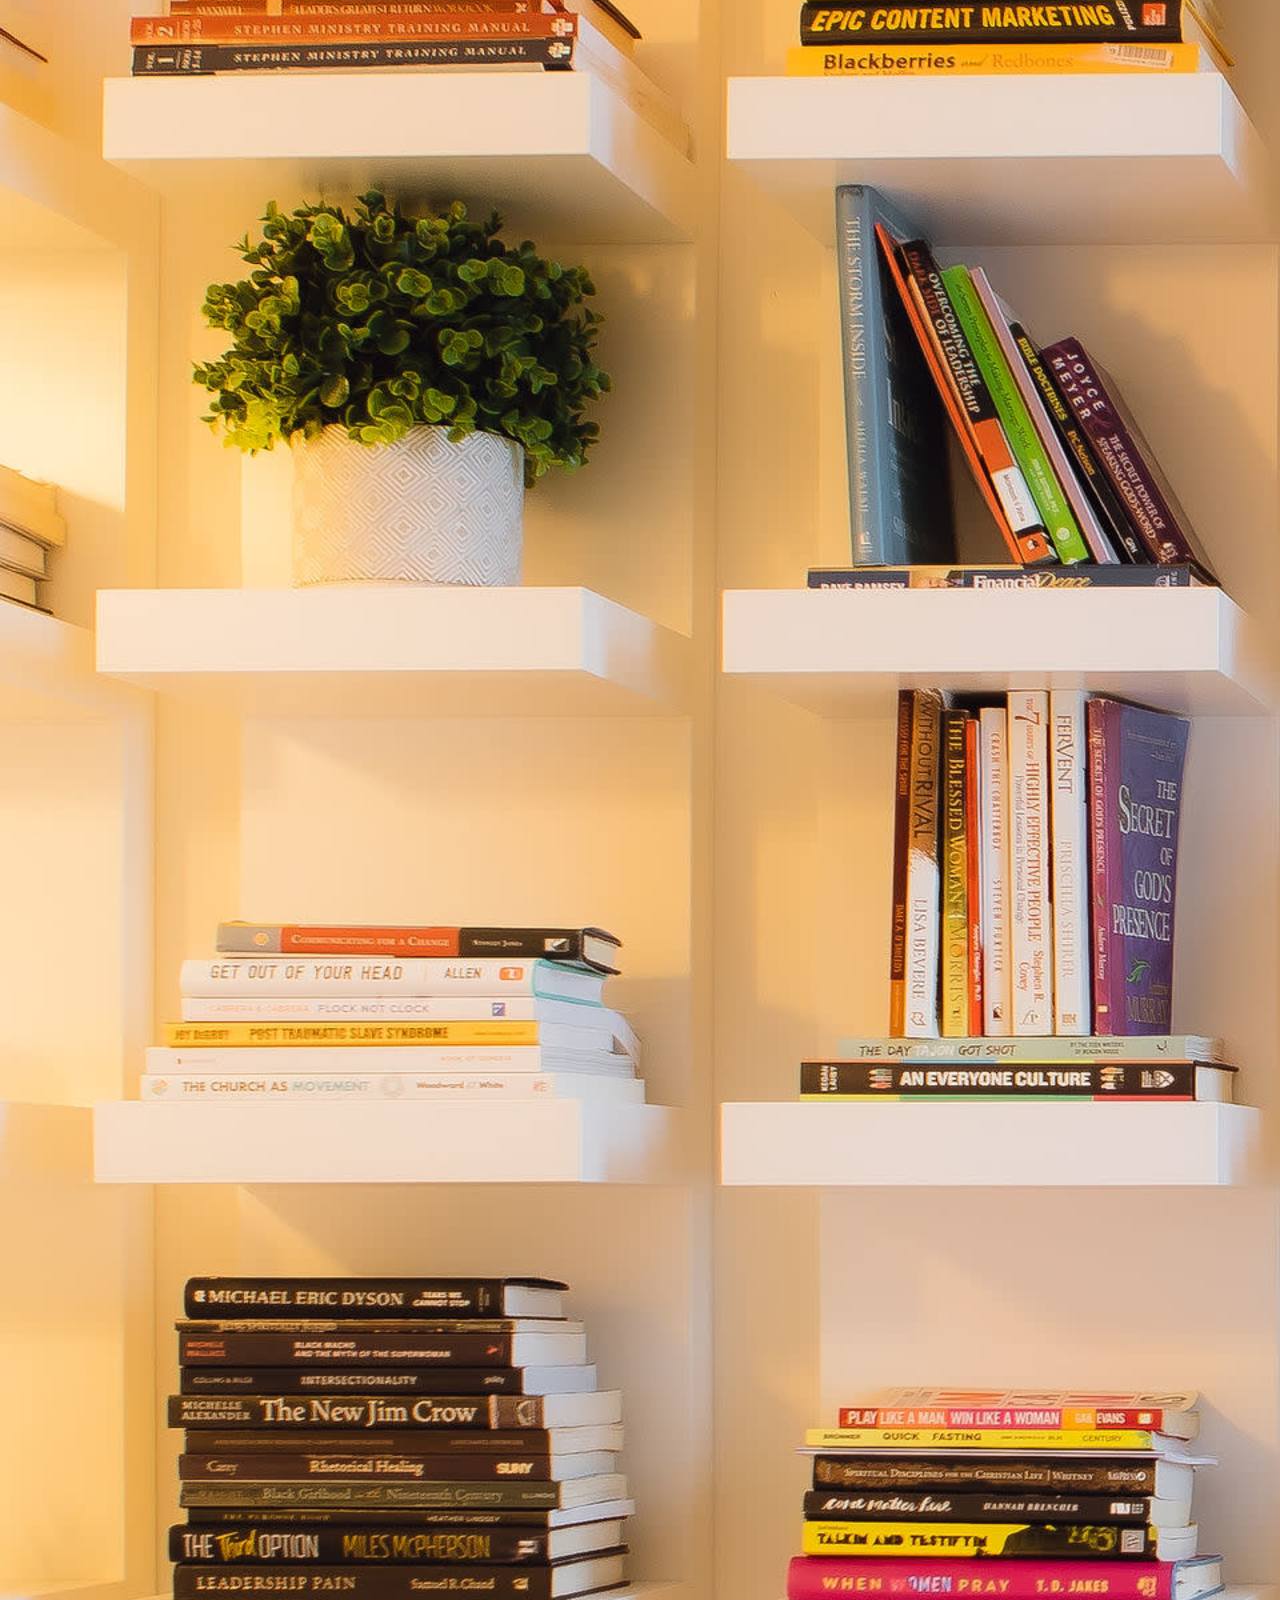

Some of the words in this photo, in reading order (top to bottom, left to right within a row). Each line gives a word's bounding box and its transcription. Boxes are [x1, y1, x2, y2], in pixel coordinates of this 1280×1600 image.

[235, 22, 300, 35] STEPHEN
[308, 22, 381, 34] MINISTRY
[388, 22, 465, 34] TRAINING
[470, 22, 530, 34] MANUAL
[812, 9, 864, 32] EPIC
[870, 7, 976, 30] CONTENT
[981, 4, 1115, 28] MARKETING
[823, 53, 955, 70] Blackberries
[1033, 366, 1067, 420] DOCTRINES
[1053, 358, 1091, 420] MEYER
[1066, 354, 1104, 411] JOYCE
[1057, 715, 1073, 794] FERVENT
[1156, 779, 1176, 800] THE
[1118, 783, 1175, 838] SECRET
[1159, 848, 1173, 866] OF
[1134, 872, 1172, 901] GOD'S
[1112, 908, 1171, 942] PRESENCE
[210, 964, 240, 979] GET
[248, 964, 278, 980] OUT
[285, 965, 308, 979] OF
[314, 966, 352, 980] YOUR
[361, 966, 402, 980] HEAD
[900, 1071, 926, 1086] AN
[928, 1071, 1012, 1087] EVERYONE
[1016, 1071, 1091, 1087] CULTURE
[208, 1291, 291, 1304] MICHAEL
[297, 1291, 337, 1305] ERIC
[342, 1291, 403, 1306] DYSON
[260, 1400, 305, 1422] The
[311, 1401, 364, 1422] New
[368, 1400, 407, 1426] Jim
[413, 1402, 477, 1423] Crow
[848, 1411, 877, 1425] PLAY
[880, 1411, 904, 1425] LIKE
[907, 1411, 916, 1425] A
[950, 1411, 973, 1425] WIN
[976, 1411, 1000, 1425] LIKE
[1004, 1411, 1012, 1425] A
[1014, 1411, 1060, 1425] WOMAN
